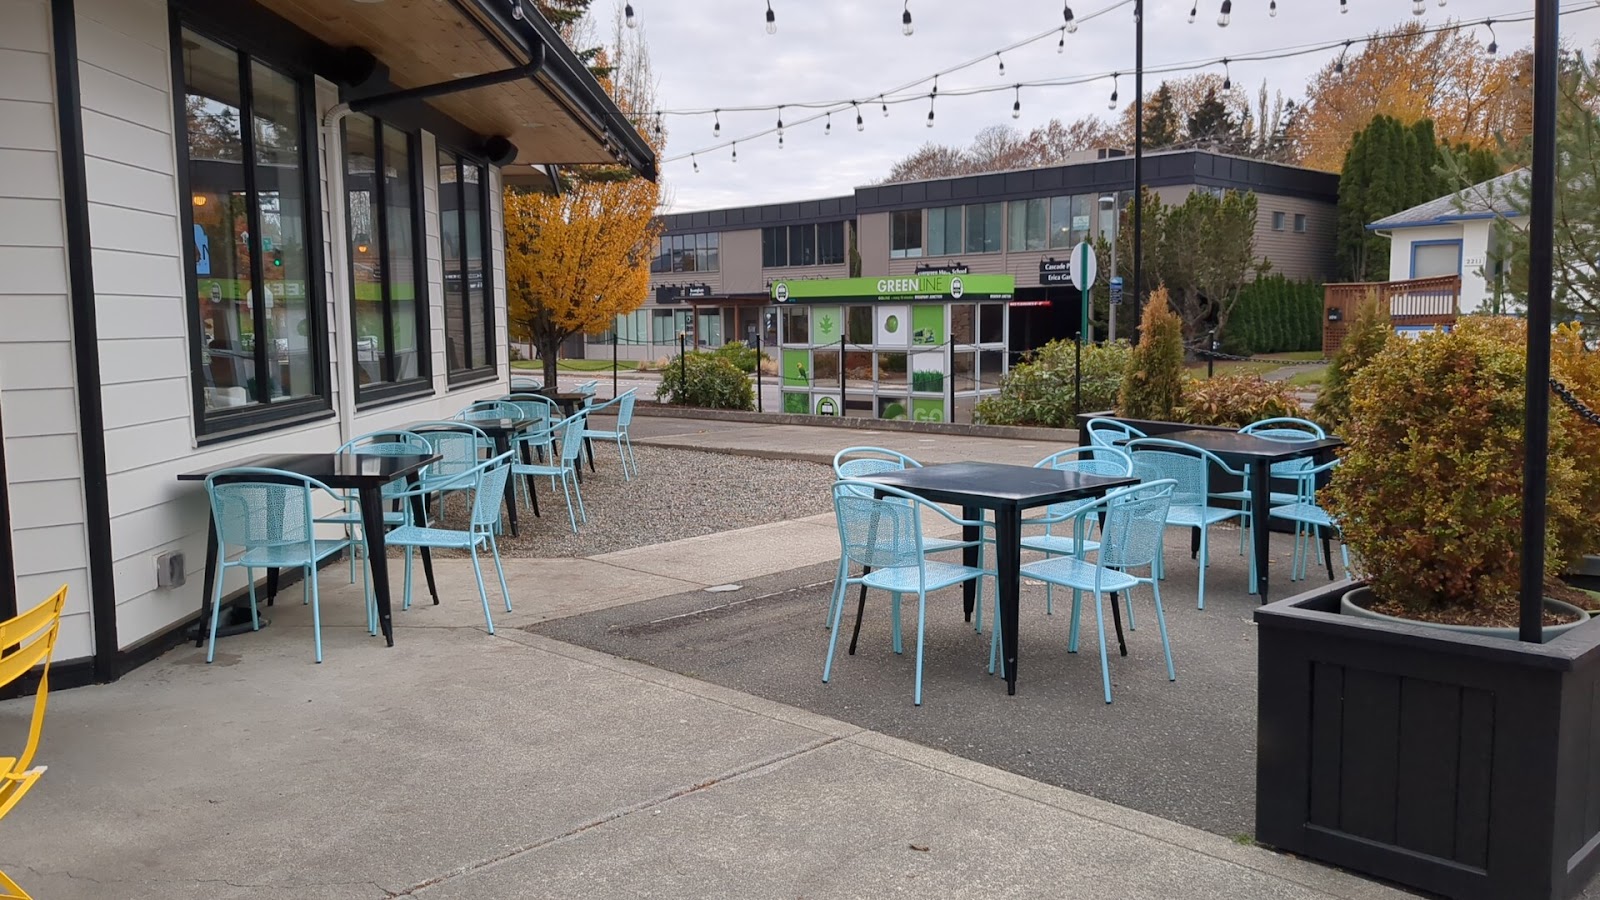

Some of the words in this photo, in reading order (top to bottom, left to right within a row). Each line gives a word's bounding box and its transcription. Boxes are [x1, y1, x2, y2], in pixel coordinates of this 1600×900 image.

[1045, 263, 1066, 271] Cascade
[1048, 273, 1061, 281] Erica
[877, 278, 942, 292] GREENLINE
